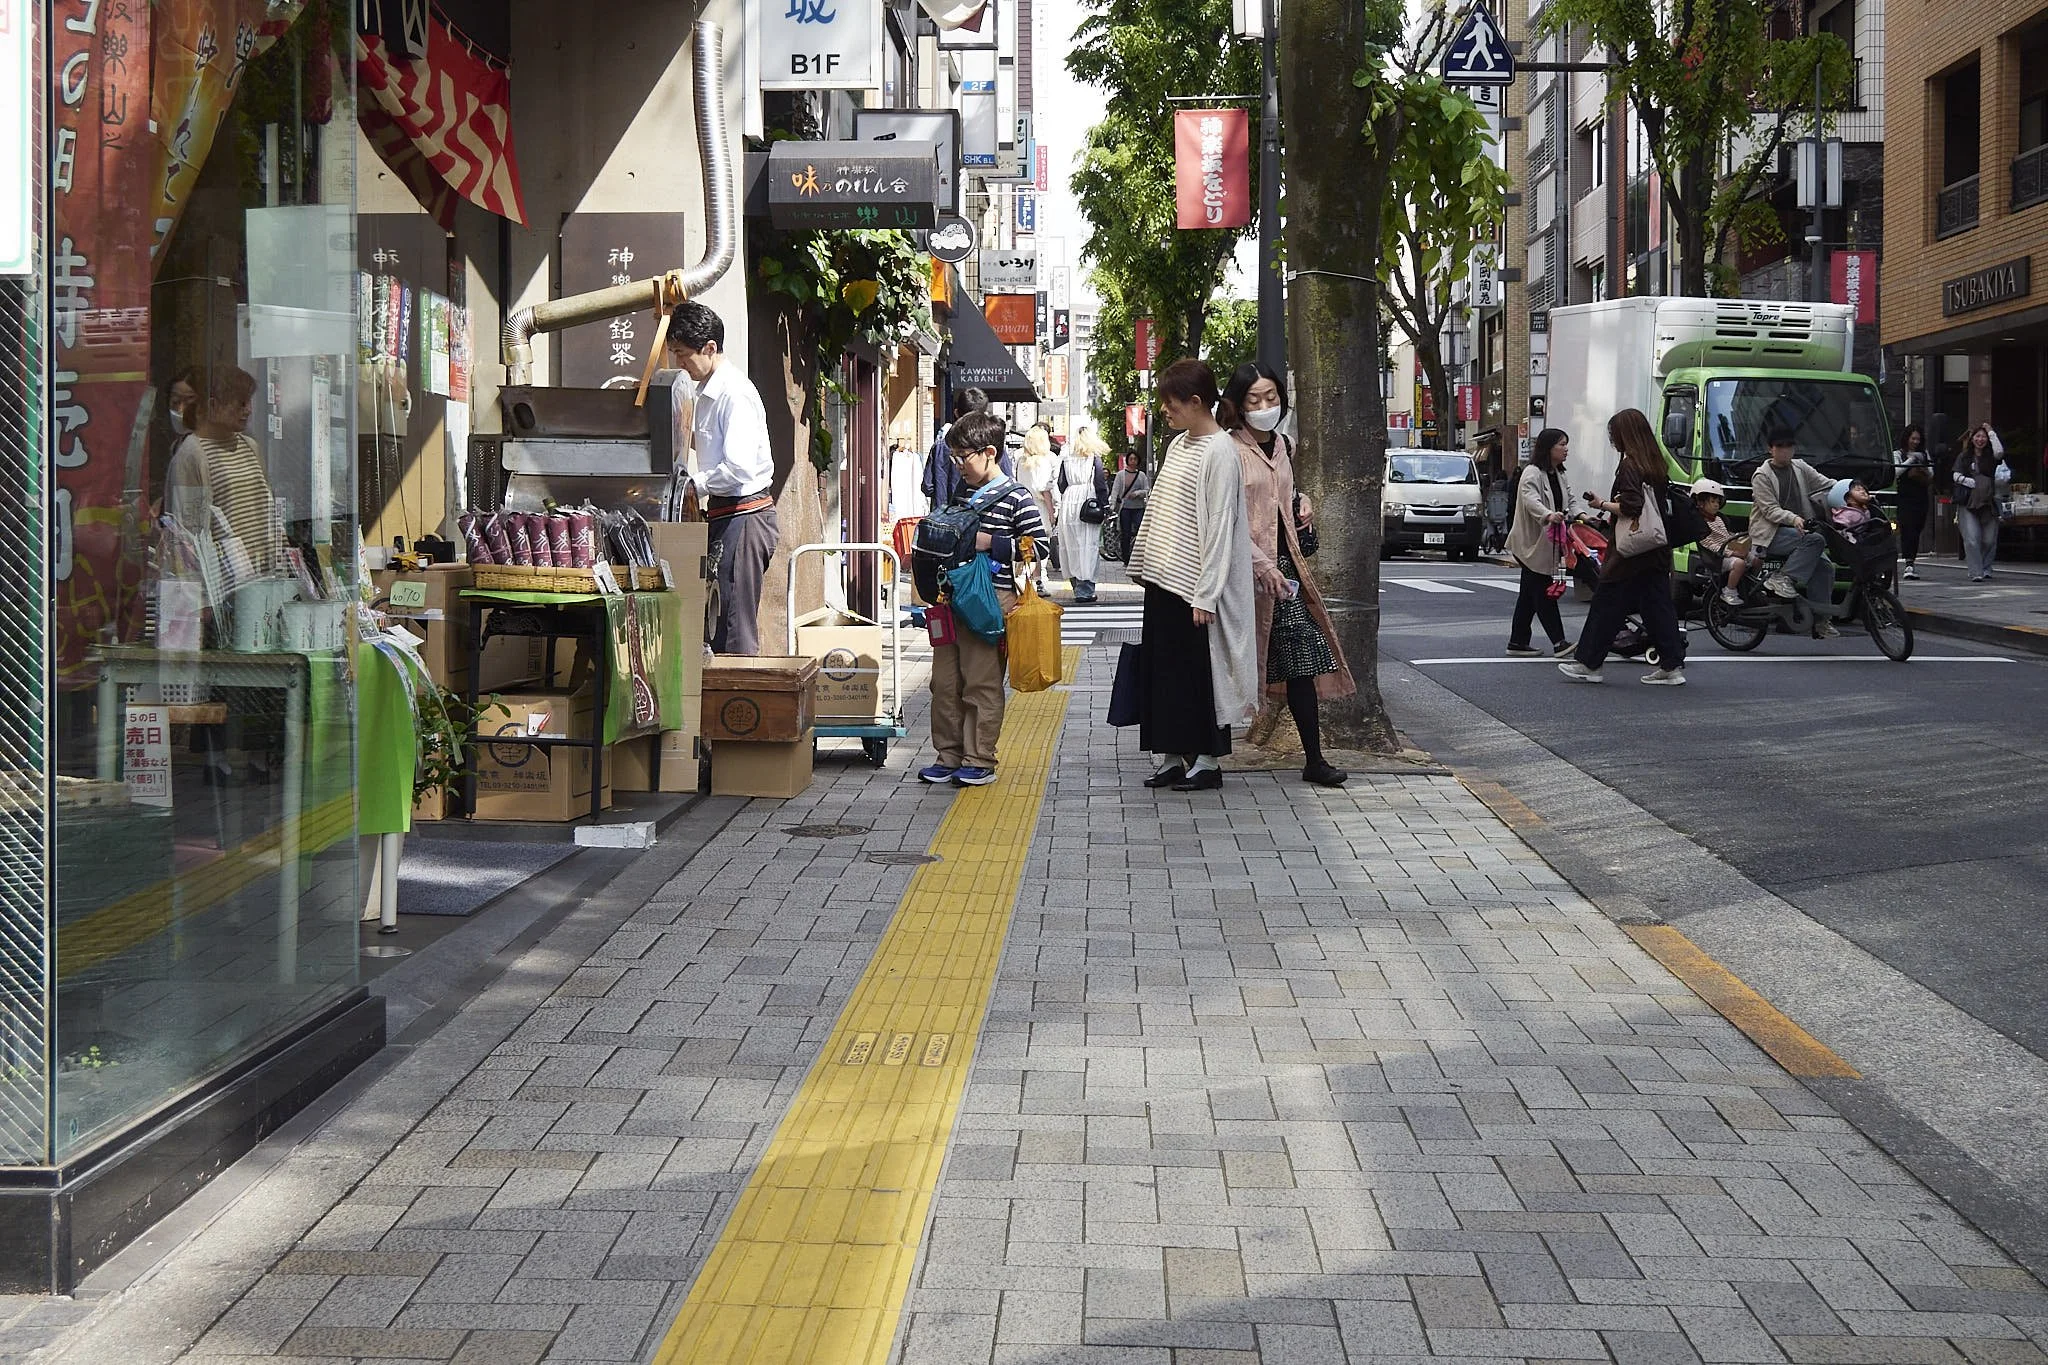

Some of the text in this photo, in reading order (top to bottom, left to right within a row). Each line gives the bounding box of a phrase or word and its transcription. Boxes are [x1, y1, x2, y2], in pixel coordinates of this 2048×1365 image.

[791, 53, 841, 75] B1F
[971, 81, 987, 91] 2F
[964, 155, 982, 164] SHK
[999, 258, 1034, 270] いろり
[1947, 266, 2016, 310] TSUBAKIYA
[1752, 311, 1780, 321] Topre
[403, 587, 420, 602] 70
